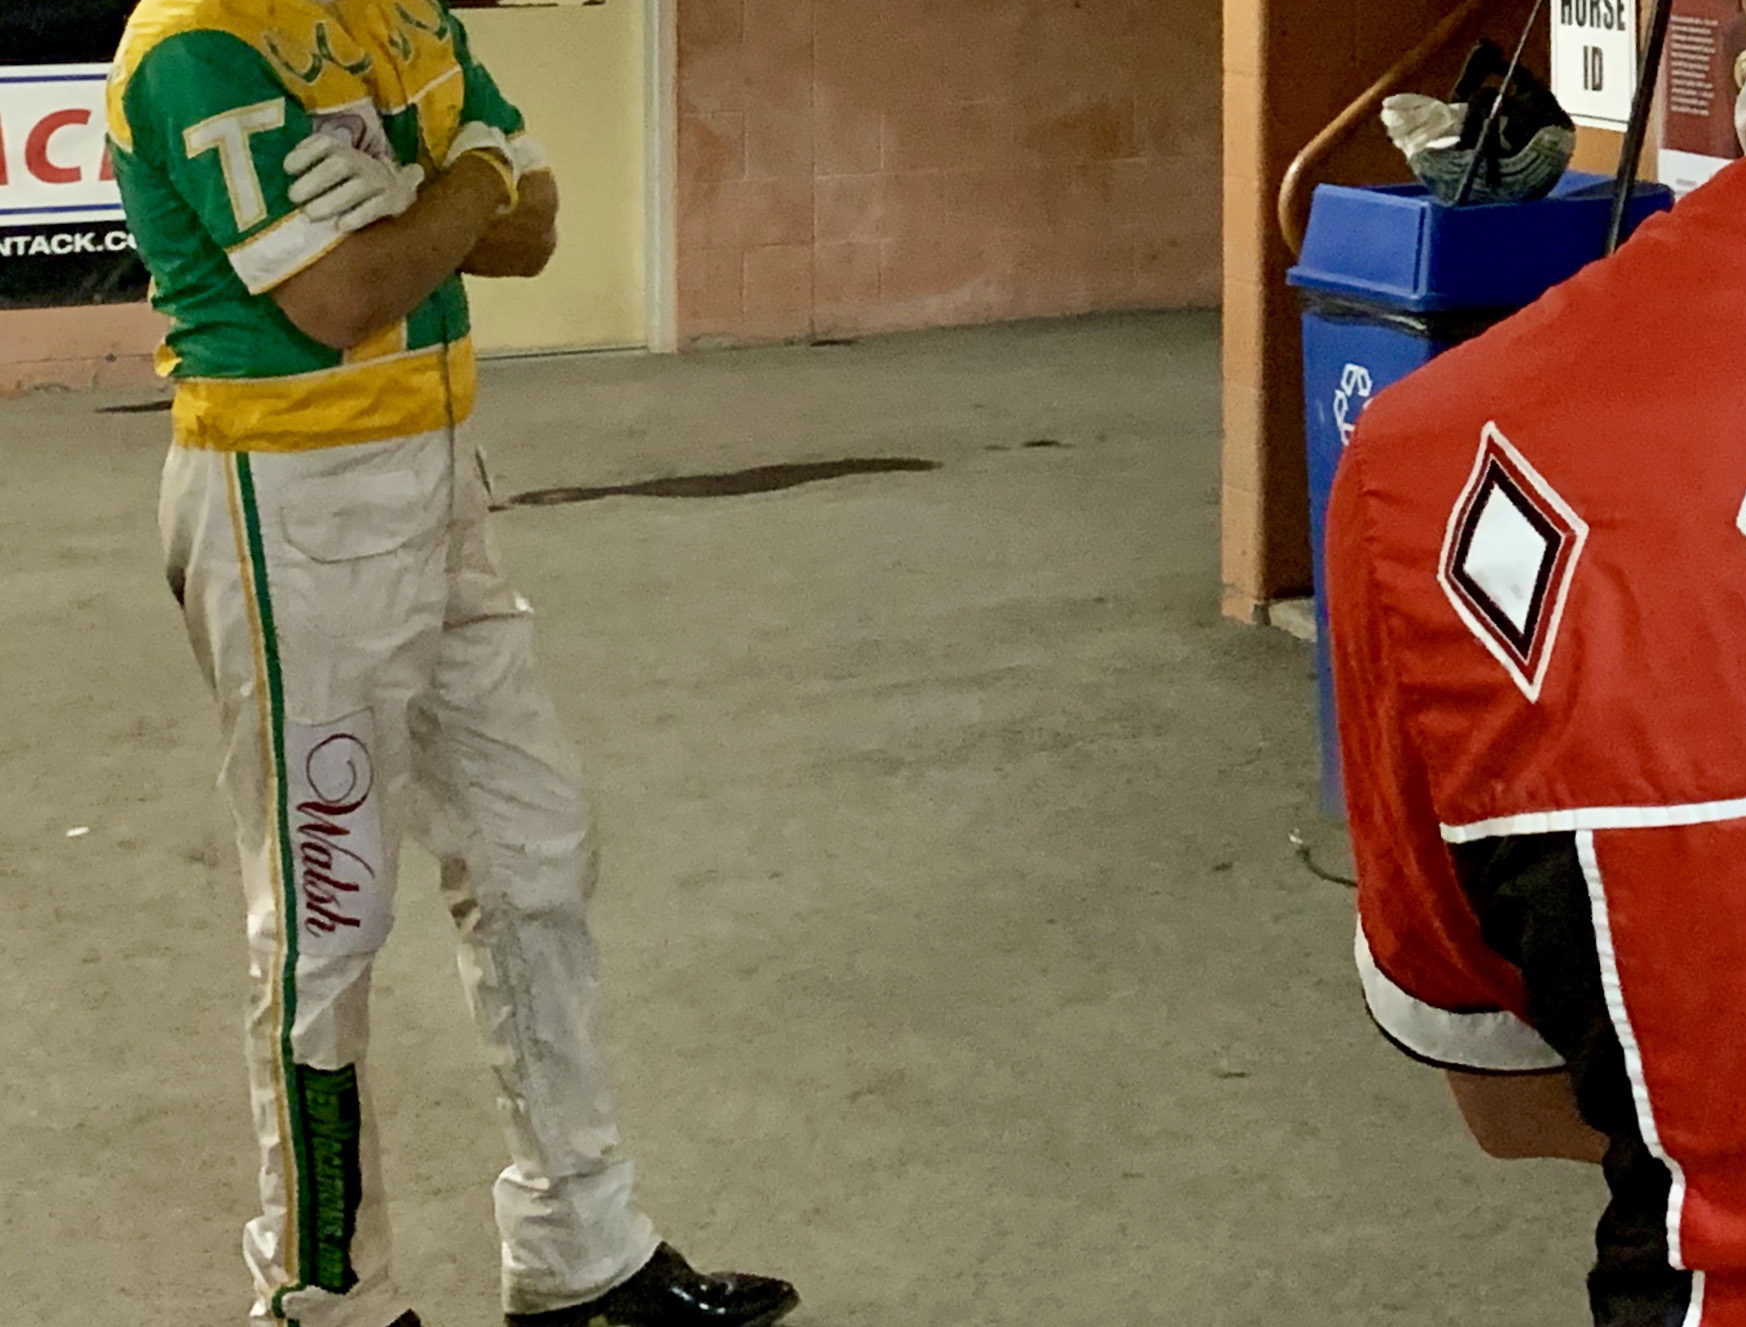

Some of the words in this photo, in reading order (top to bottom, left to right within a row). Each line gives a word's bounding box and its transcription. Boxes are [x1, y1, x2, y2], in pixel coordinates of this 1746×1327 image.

[1583, 45, 1605, 92] ID
[182, 97, 286, 234] T
[296, 733, 375, 939] Walsh
